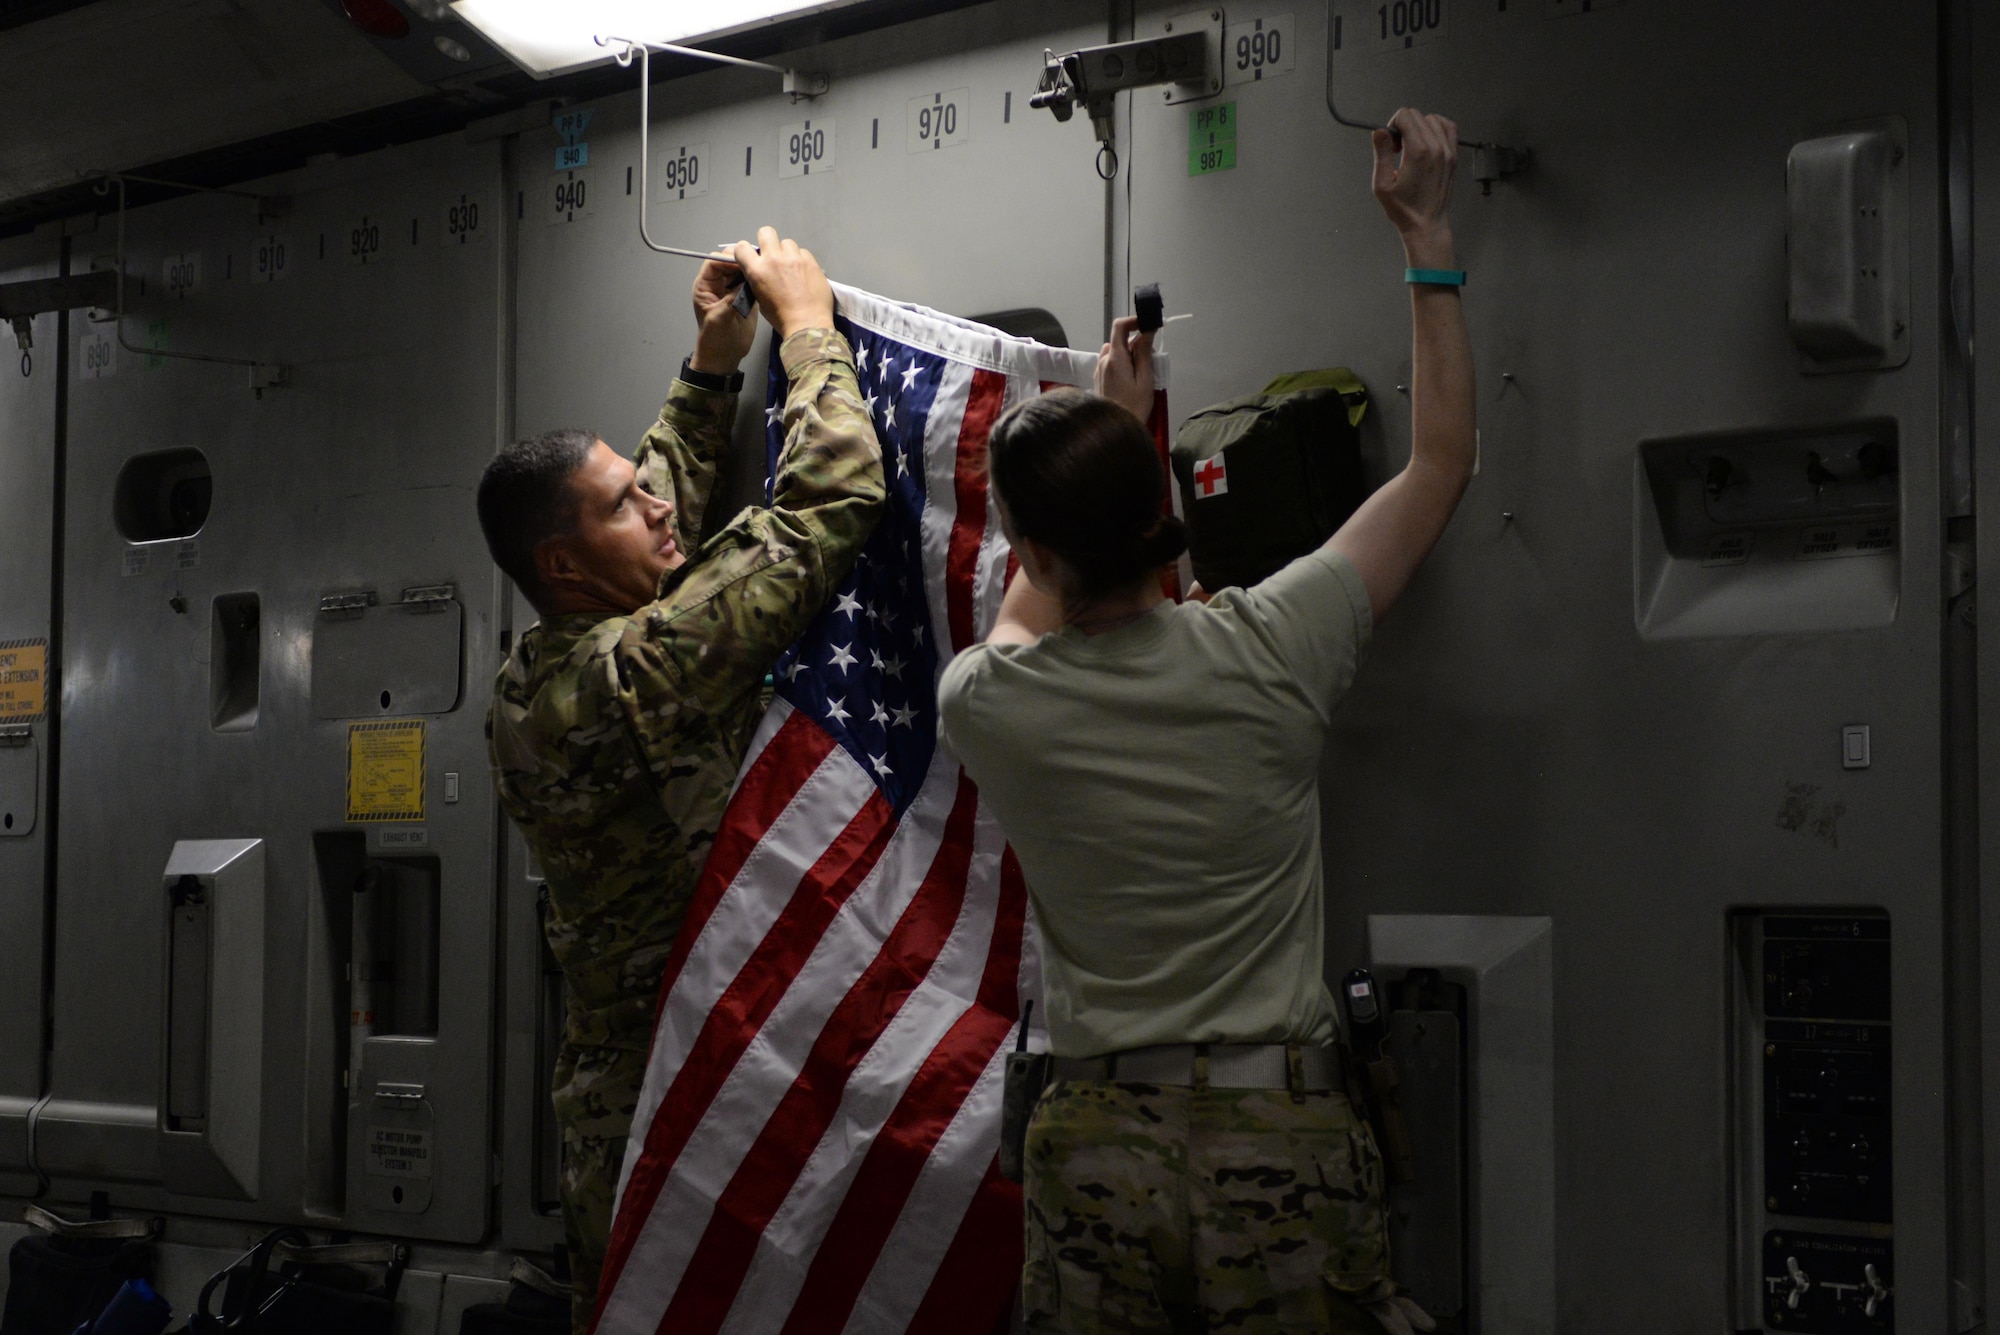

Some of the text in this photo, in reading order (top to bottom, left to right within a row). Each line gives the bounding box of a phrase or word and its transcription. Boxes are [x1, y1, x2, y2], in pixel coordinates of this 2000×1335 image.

[1378, 0, 1440, 39] 1000
[1237, 29, 1281, 70] 990
[561, 113, 583, 131] PP 6
[919, 103, 957, 139] 970
[1197, 106, 1227, 129] PP 8
[789, 129, 825, 165] 960
[563, 148, 580, 165] 940
[1200, 150, 1223, 170] 987
[666, 155, 699, 189] 950
[555, 180, 586, 213] 940
[449, 203, 478, 234] 930
[352, 226, 379, 255] 920
[259, 244, 285, 272] 910
[170, 262, 194, 290] 900
[87, 342, 110, 369] 890
[1803, 543, 1839, 554] OXYGEN
[1856, 538, 1893, 550] OXYGEN
[1710, 549, 1744, 560] OXYGEN
[4, 669, 39, 684] EXTENSION
[383, 832, 423, 842] EXHAUST VENT
[1852, 922, 1860, 936] 6
[1805, 1025, 1817, 1039] 17
[1856, 1027, 1869, 1042] 18
[385, 1131, 404, 1143] MOTOR
[406, 1133, 422, 1145] PUMP
[399, 1146, 427, 1159] MANIFOLD
[384, 1158, 407, 1170] SYSTEM
[1811, 1241, 1857, 1252] EQUALIZATION
